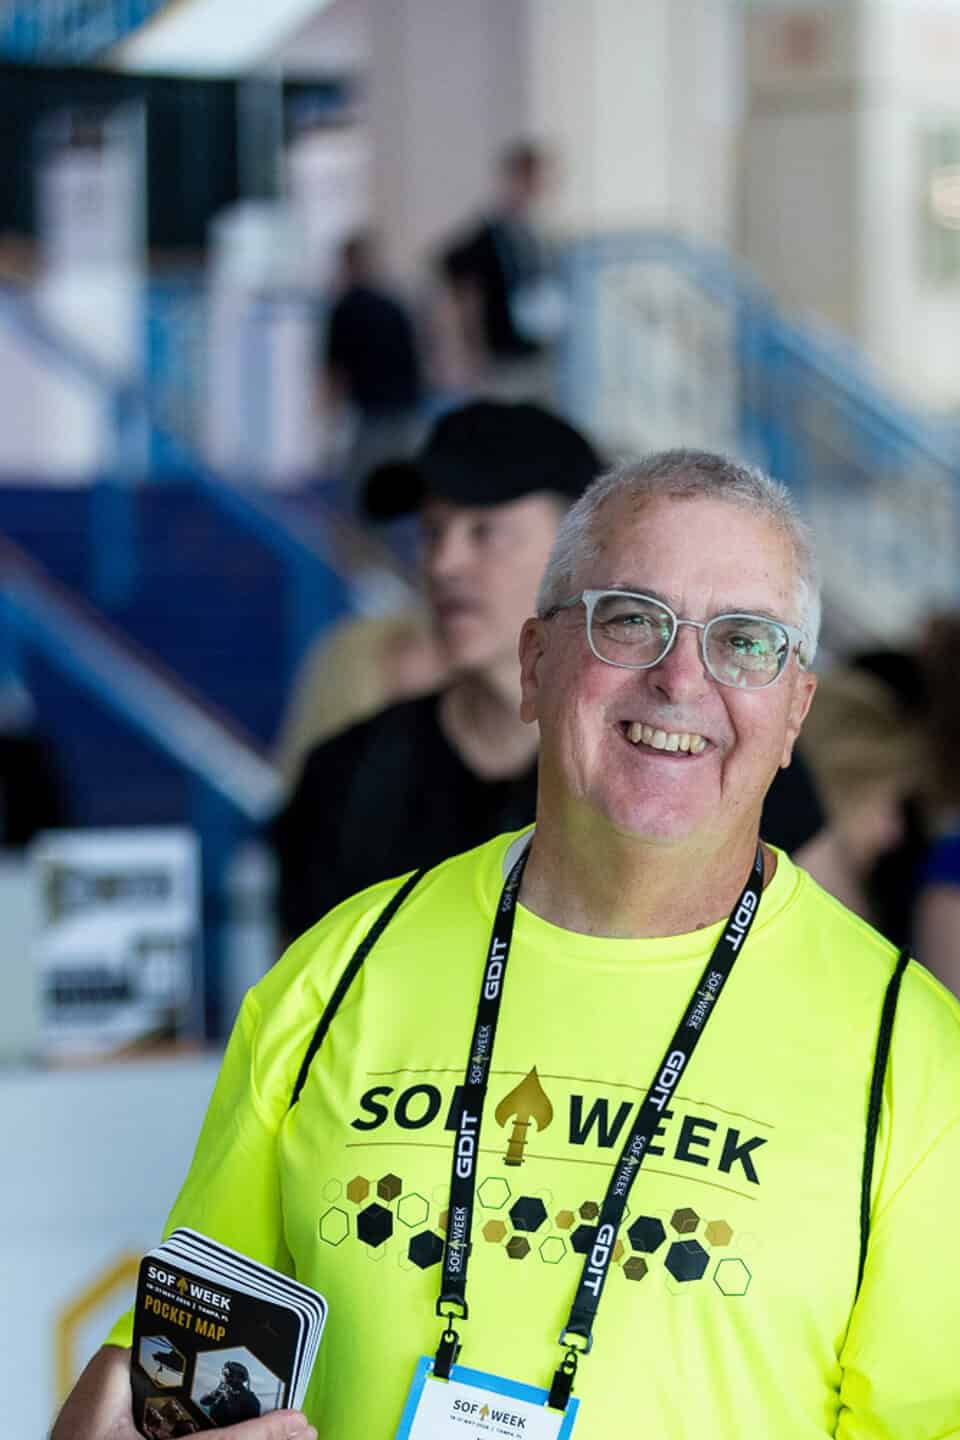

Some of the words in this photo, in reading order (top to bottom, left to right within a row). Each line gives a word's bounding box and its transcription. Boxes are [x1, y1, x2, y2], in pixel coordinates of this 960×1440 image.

[725, 890, 758, 951] GDIT
[484, 938, 507, 1000] GDIT
[707, 971, 723, 992] SOF
[688, 1000, 708, 1029] WEEK
[470, 1064, 482, 1085] SOF
[476, 1024, 491, 1054] WEEK
[649, 1051, 686, 1112] GDIT
[456, 1110, 477, 1178] GDIT
[631, 1135, 646, 1156] SOF
[614, 1167, 633, 1196] WEEK
[453, 1207, 466, 1239] WEEK
[449, 1251, 461, 1273] SOF
[583, 1223, 615, 1297] GDIT
[147, 1266, 176, 1286] SOF
[190, 1283, 231, 1311] WEEK
[144, 1295, 192, 1329] POCKET
[195, 1318, 226, 1342] MAP
[453, 1400, 478, 1414] SOF
[491, 1409, 527, 1429] WEEK
